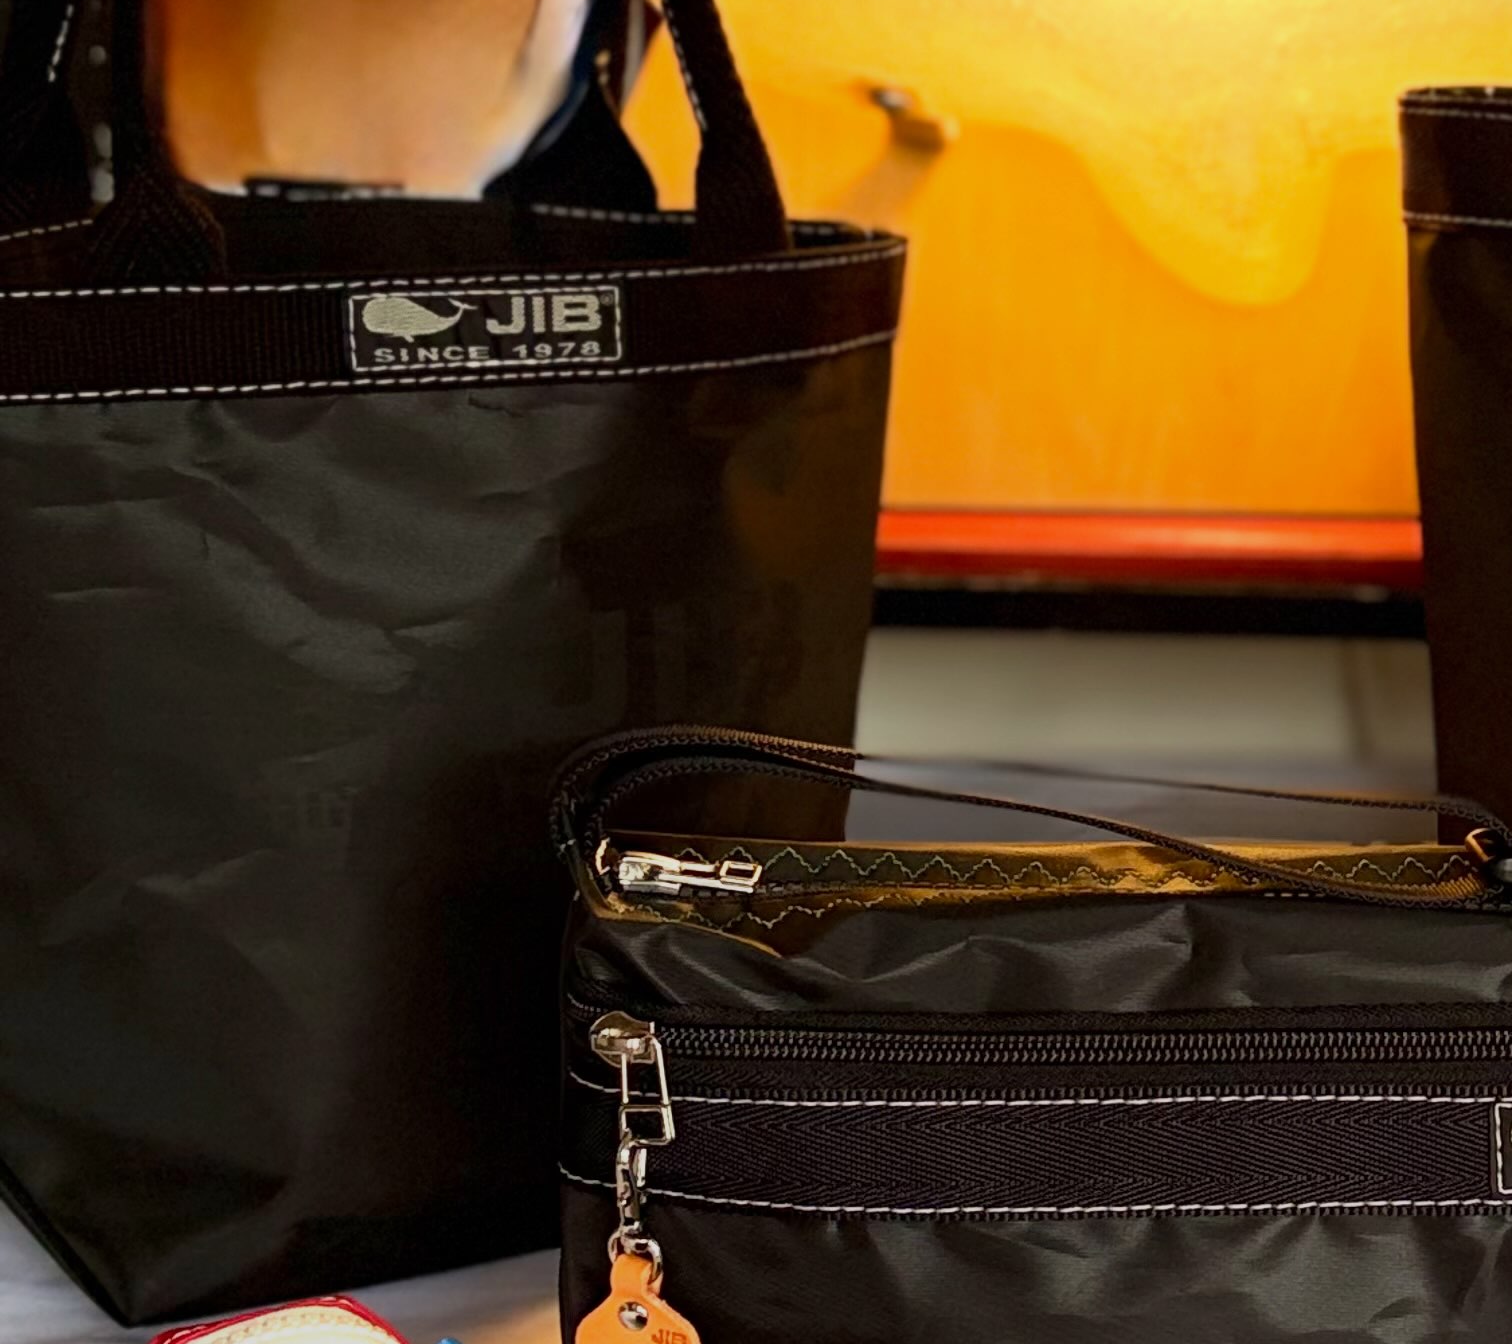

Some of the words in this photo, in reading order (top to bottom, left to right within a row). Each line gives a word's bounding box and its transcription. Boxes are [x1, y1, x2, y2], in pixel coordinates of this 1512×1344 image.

[486, 294, 602, 335] JIB
[374, 345, 490, 363] SINCE
[512, 341, 601, 359] 1978
